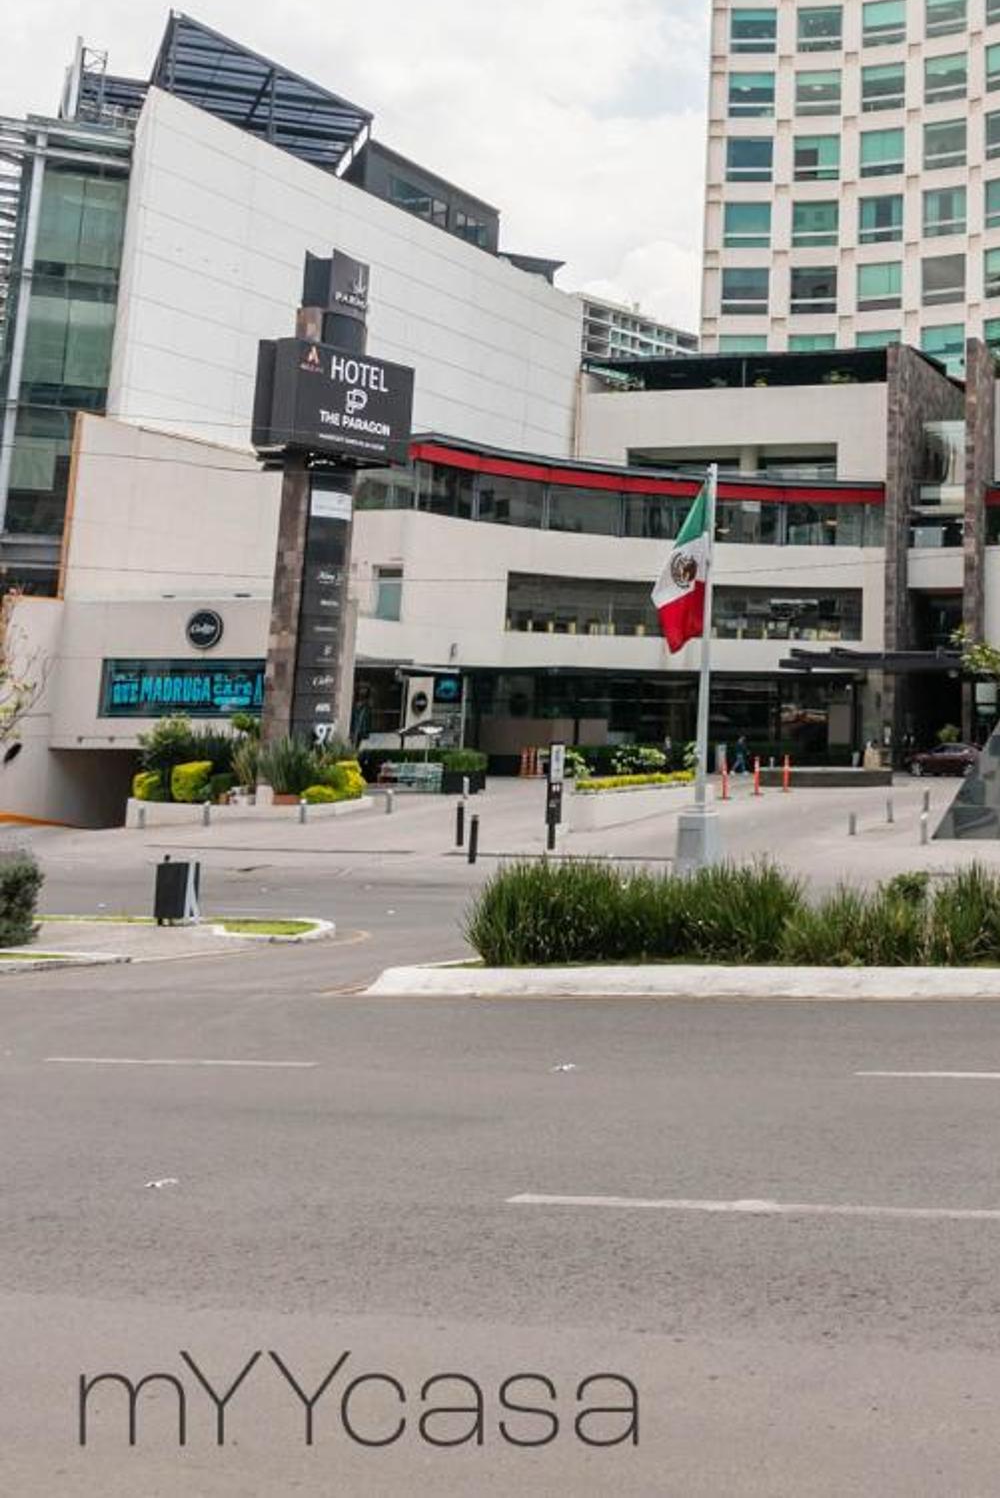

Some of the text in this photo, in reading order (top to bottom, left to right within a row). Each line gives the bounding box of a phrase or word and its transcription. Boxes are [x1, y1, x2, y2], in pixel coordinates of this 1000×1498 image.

[331, 355, 389, 392] HOTEL
[319, 409, 390, 437] THE PARAGON
[140, 676, 211, 702] MADRUGA
